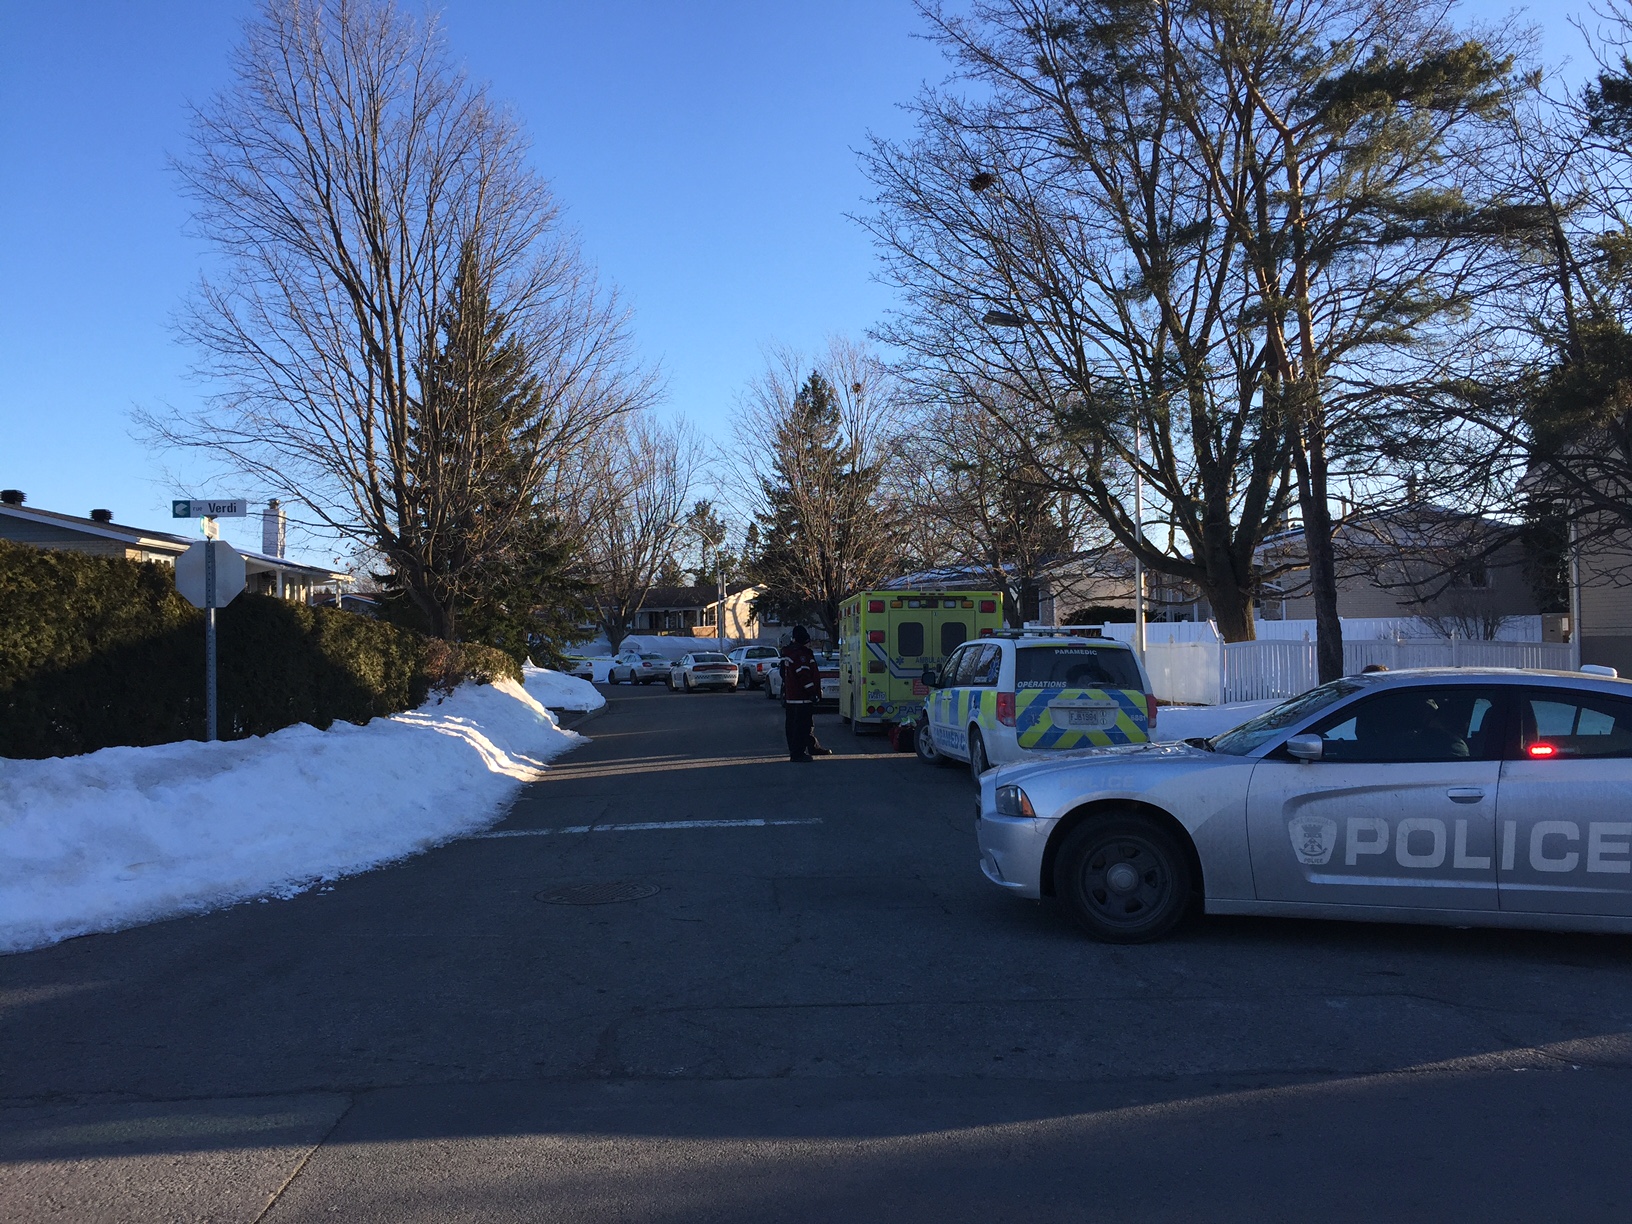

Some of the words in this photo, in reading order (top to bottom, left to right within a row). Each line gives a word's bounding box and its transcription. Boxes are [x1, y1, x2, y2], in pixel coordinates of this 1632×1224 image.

[208, 502, 237, 513] Verdi
[1017, 679, 1067, 688] OPÉRATIONS
[1059, 775, 1135, 790] POLICE
[1344, 817, 1632, 874] POLICE
